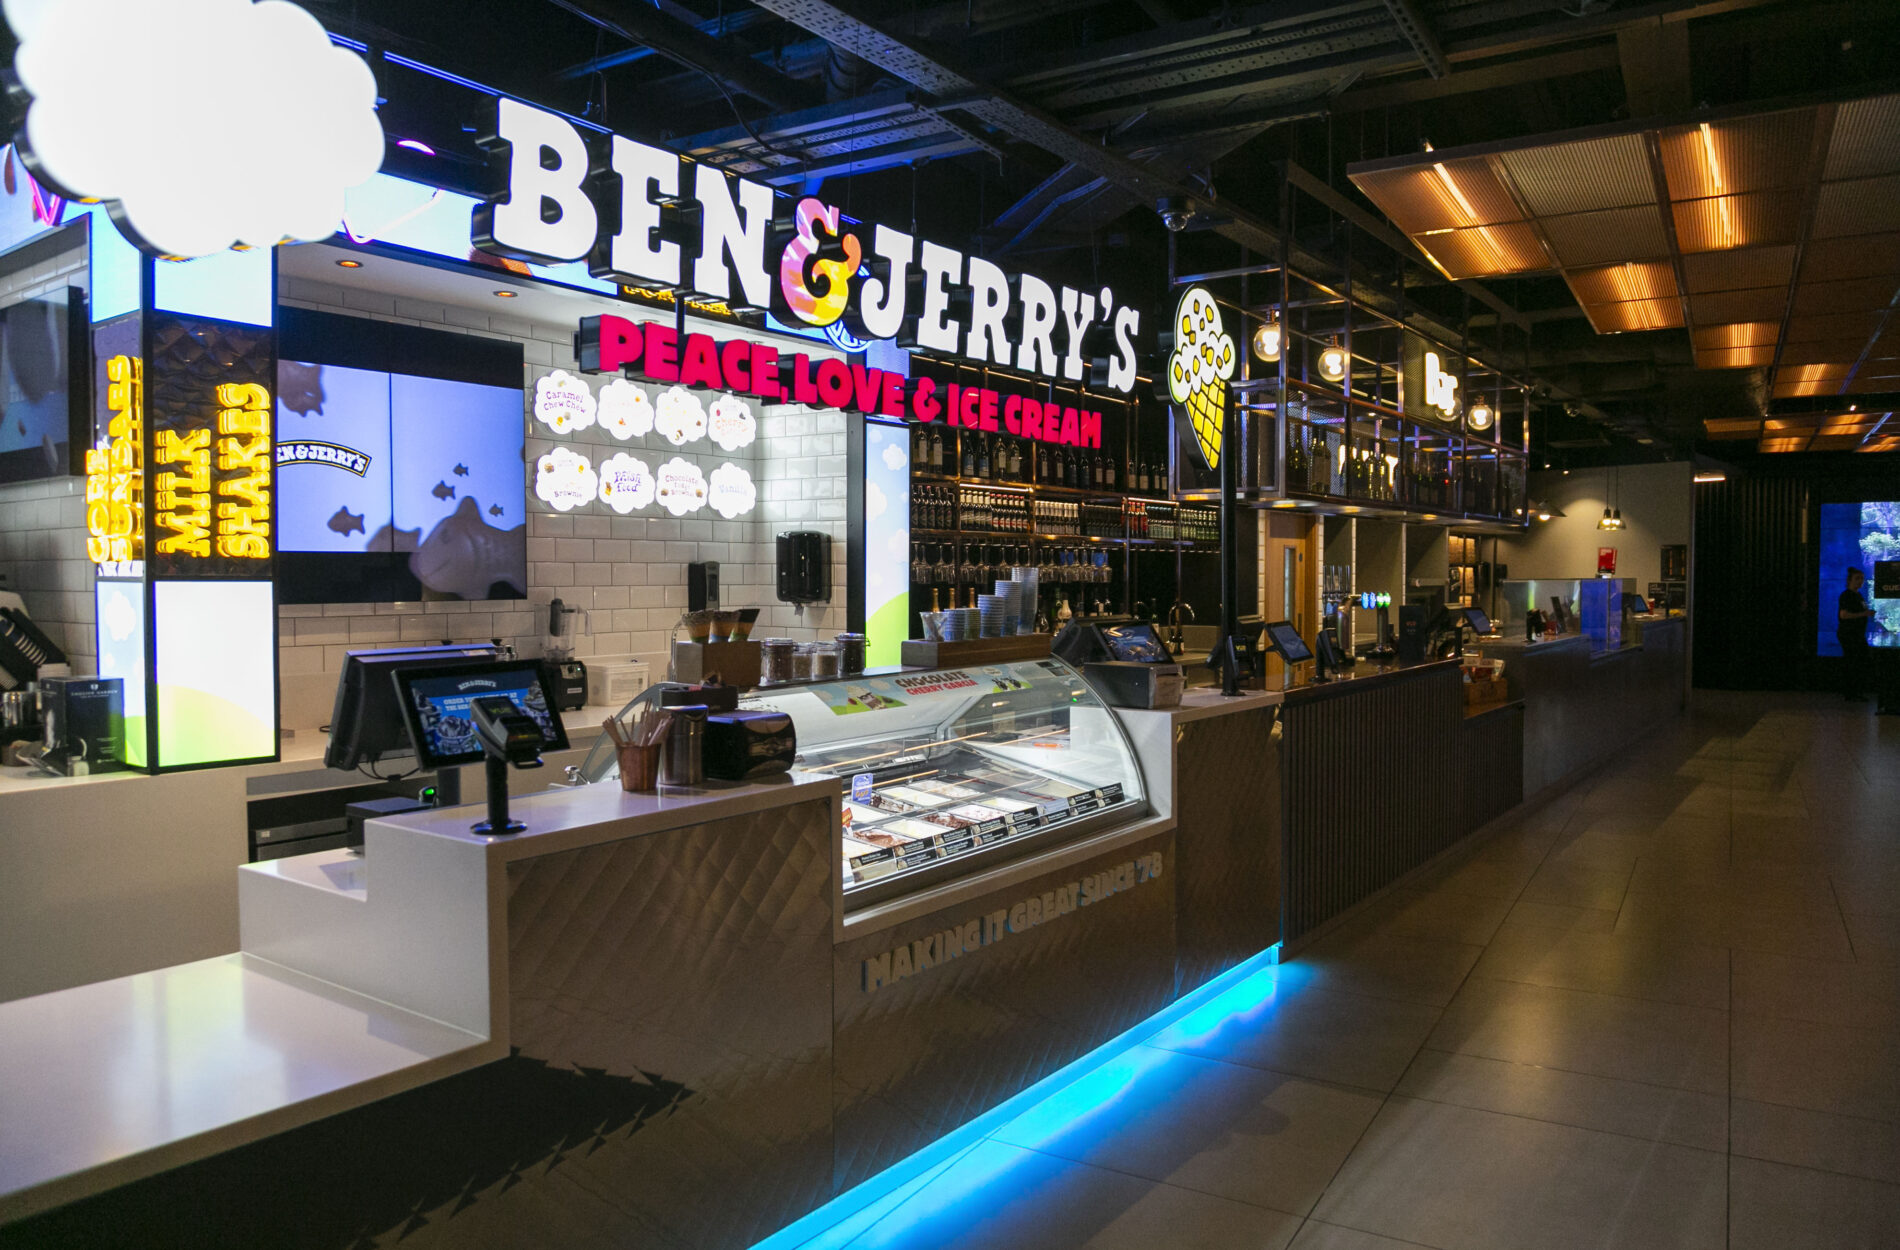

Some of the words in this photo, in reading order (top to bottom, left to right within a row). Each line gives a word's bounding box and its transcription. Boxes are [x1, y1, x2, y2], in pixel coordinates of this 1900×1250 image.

[600, 313, 788, 404] PEACE,
[794, 352, 905, 417] LOVE
[912, 378, 942, 423] &
[947, 383, 999, 432] ICE
[1004, 394, 1102, 449] CREAM
[154, 428, 212, 558] MILK
[216, 382, 271, 559] SHAKES
[895, 670, 970, 688] CHOCOLATE
[906, 683, 944, 696] CHERRY
[943, 679, 979, 690] GARCIA
[861, 918, 980, 993] MAKING
[980, 909, 1007, 946] IT
[1006, 881, 1080, 933] GREAT
[1079, 861, 1136, 907] SINCE
